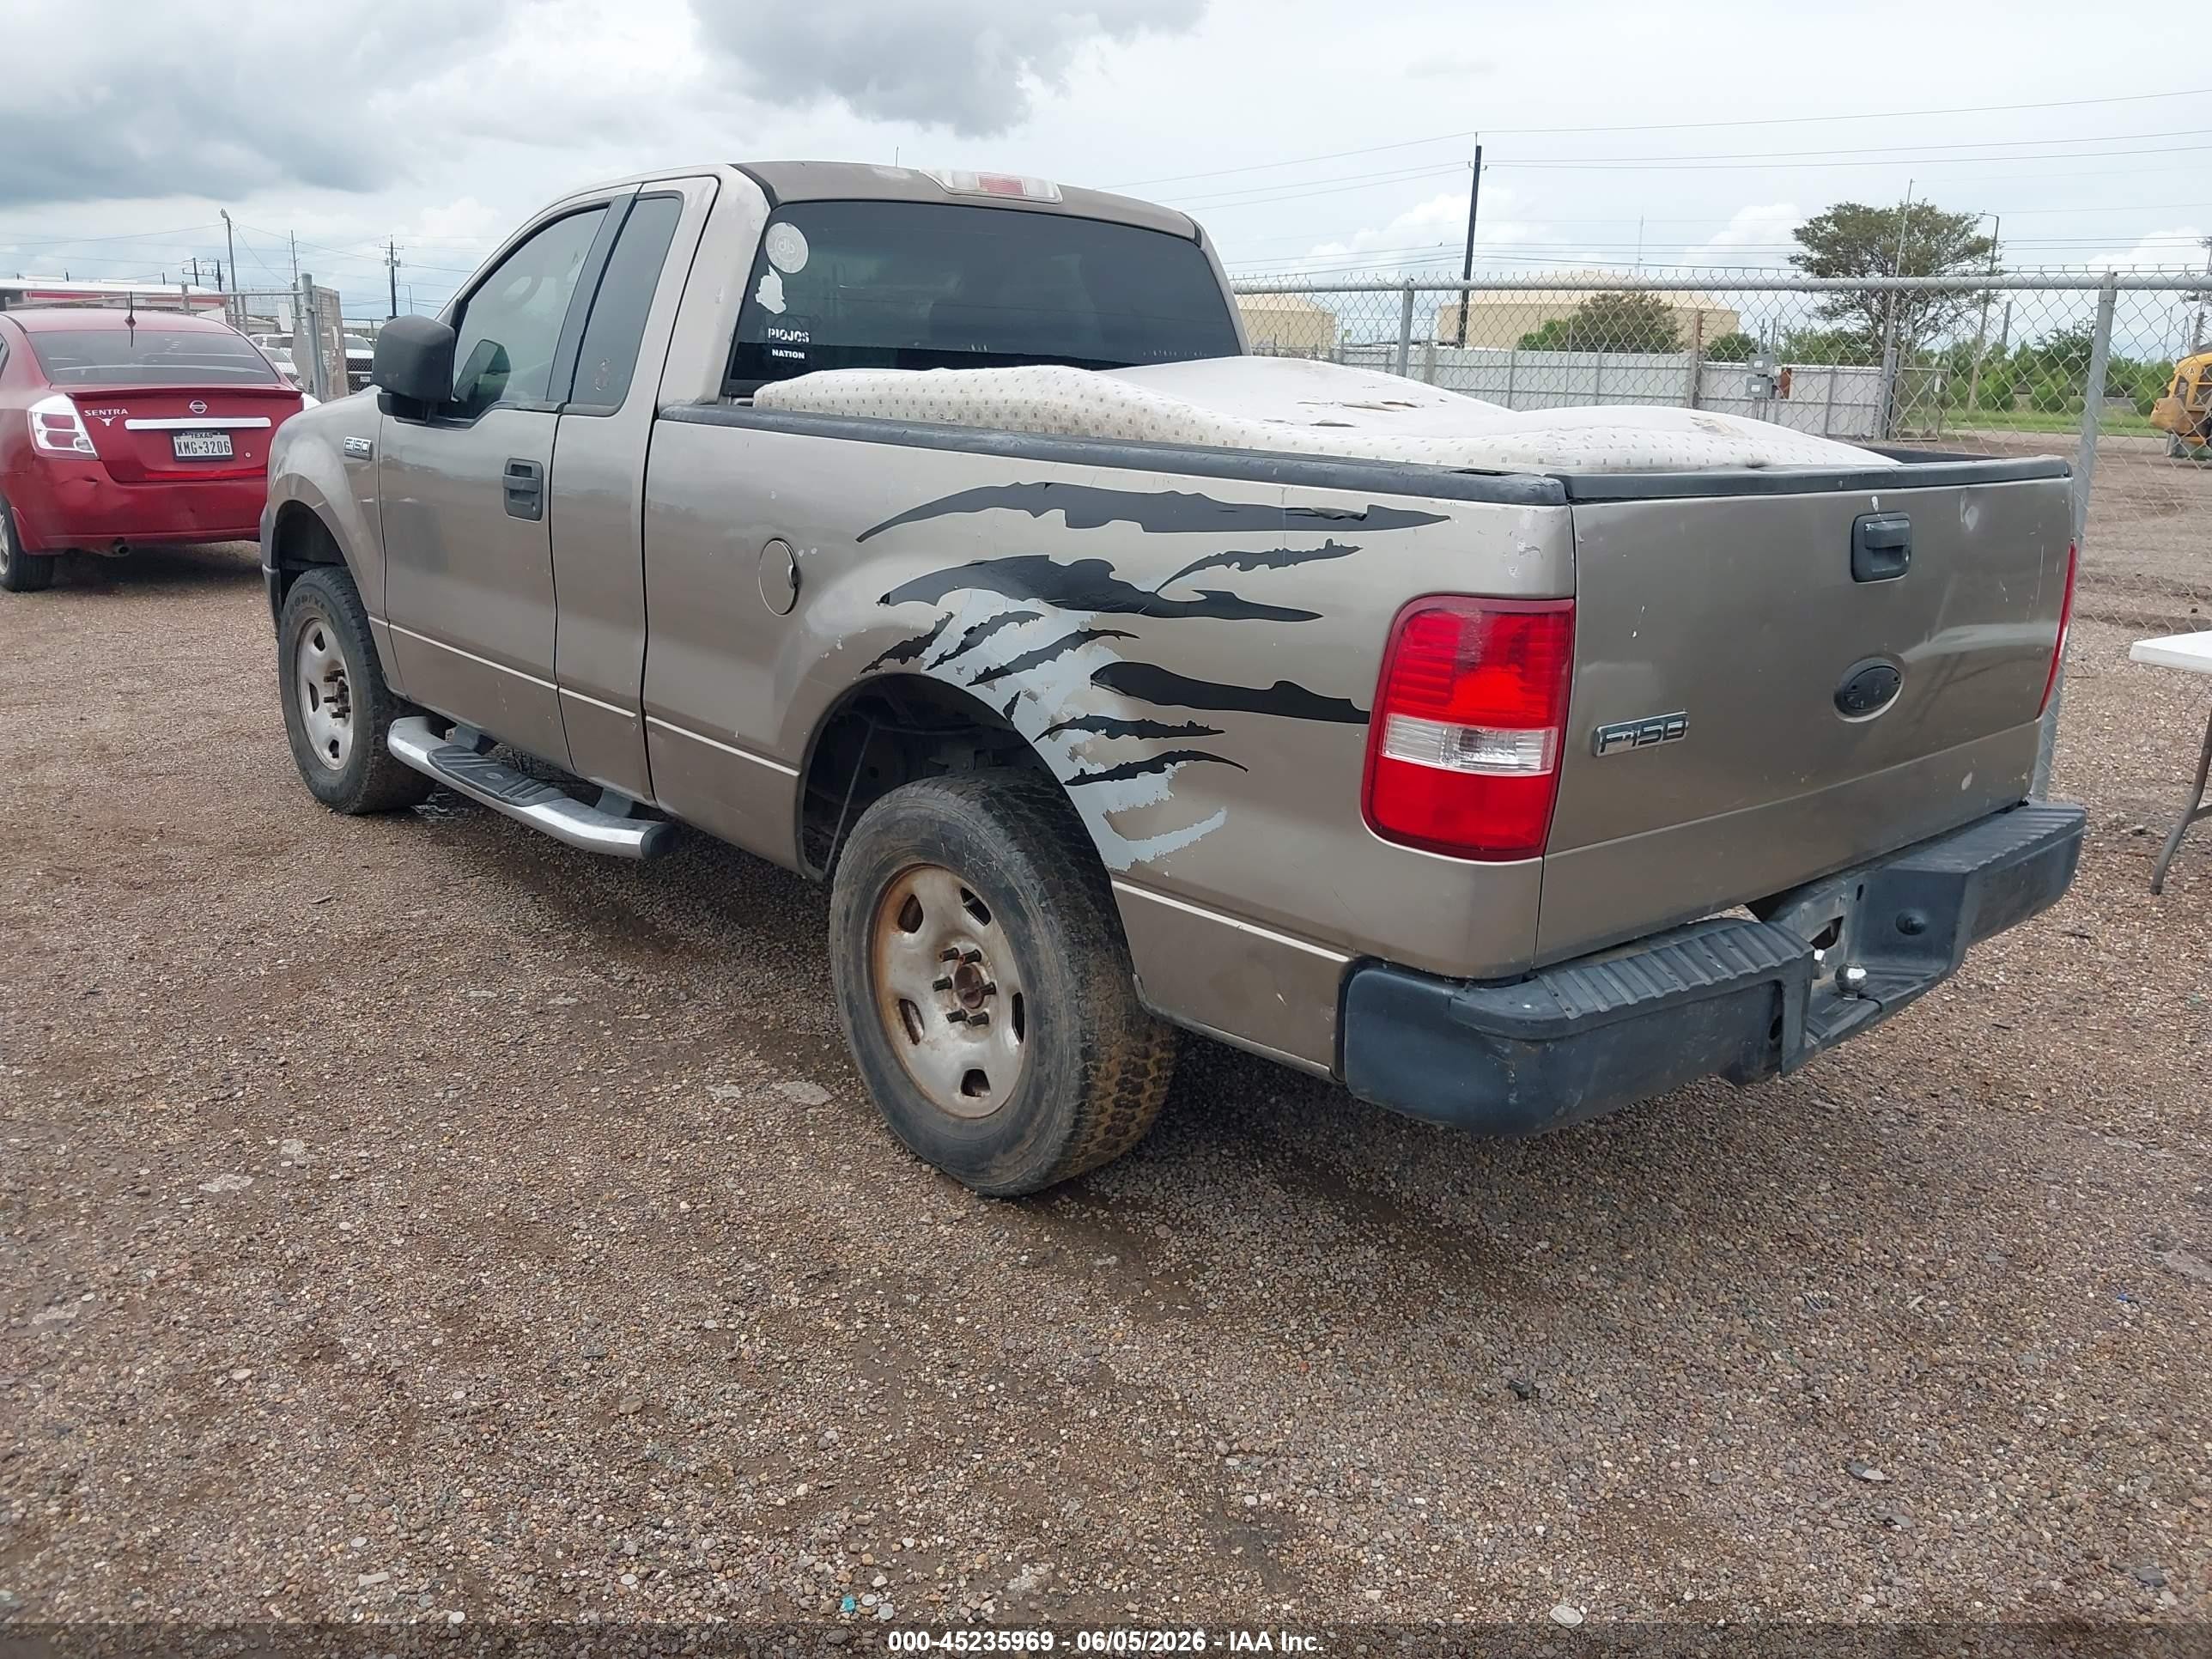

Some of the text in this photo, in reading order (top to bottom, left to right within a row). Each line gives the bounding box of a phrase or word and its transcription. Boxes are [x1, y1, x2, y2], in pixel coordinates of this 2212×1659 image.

[769, 327, 810, 343] PIOJOS
[772, 349, 805, 360] NATION
[84, 408, 129, 416] SENTRA
